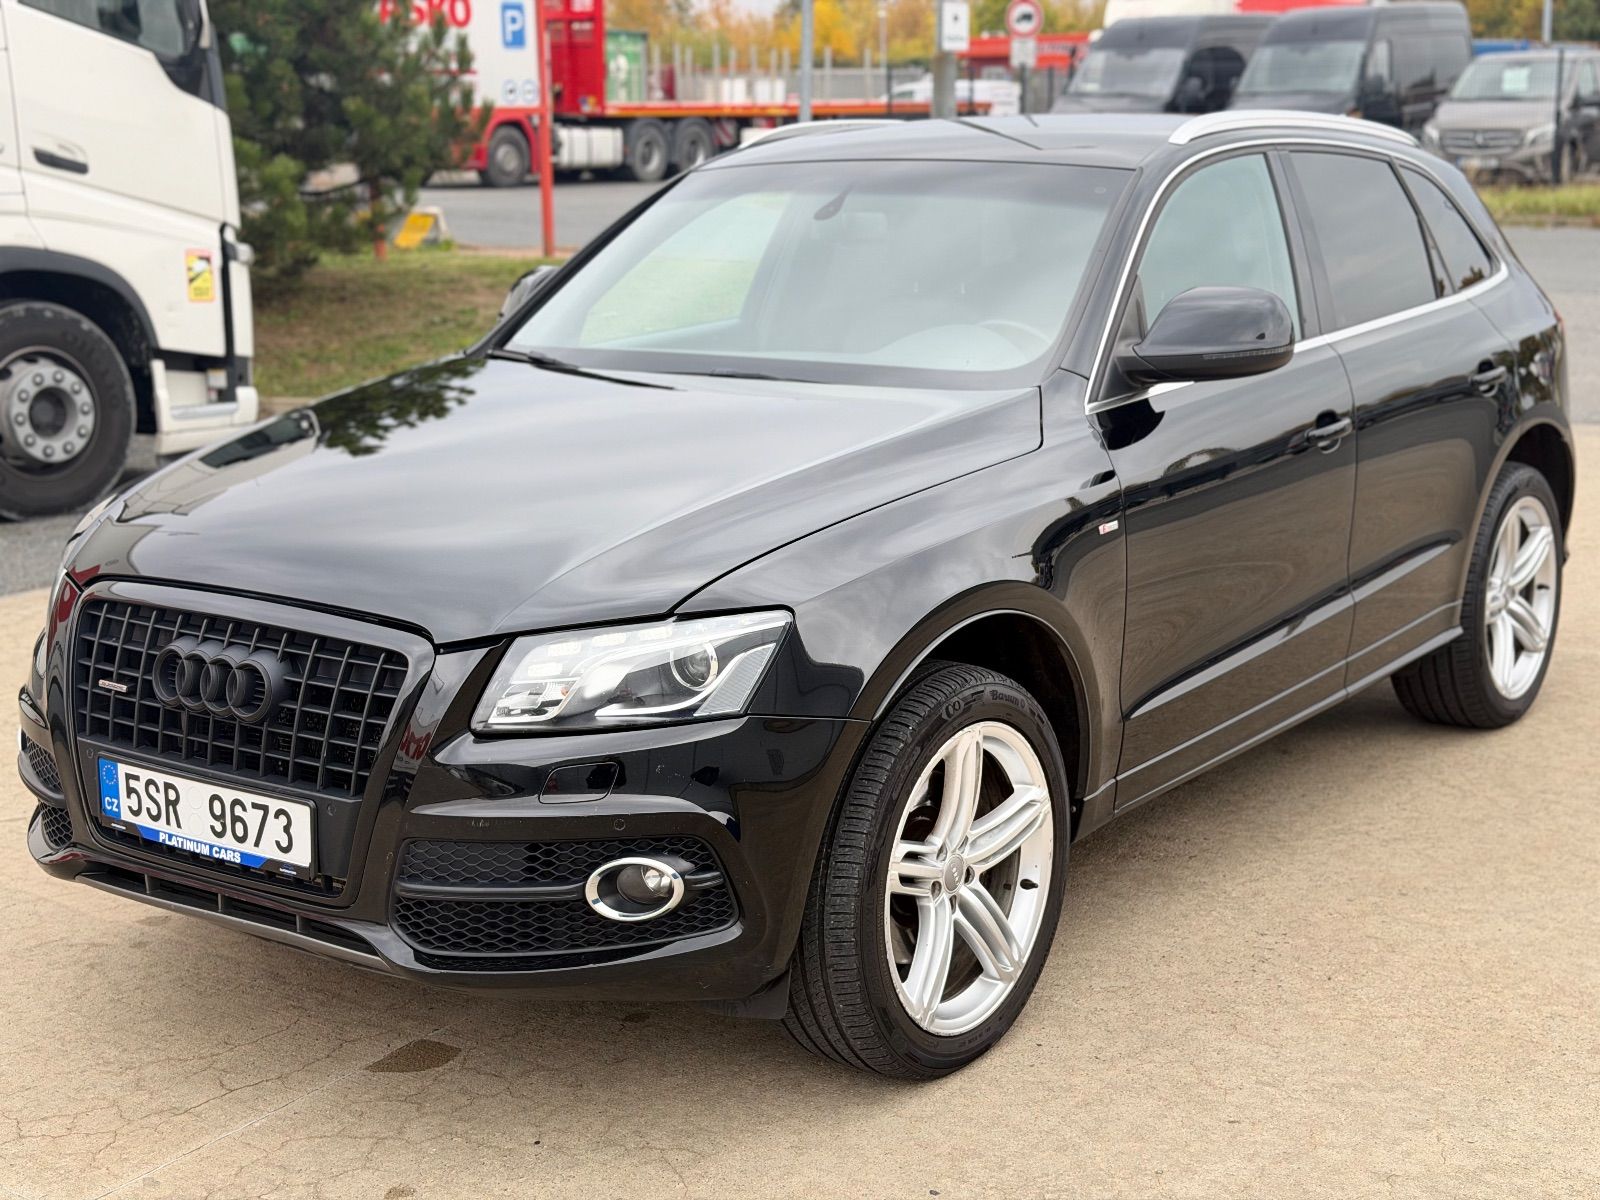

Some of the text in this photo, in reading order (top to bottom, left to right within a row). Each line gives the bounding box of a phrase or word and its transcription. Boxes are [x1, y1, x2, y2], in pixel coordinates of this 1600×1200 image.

[503, 9, 524, 43] P
[104, 796, 119, 813] CZ
[124, 772, 294, 854] 5SR 9673
[159, 831, 242, 864] PLATINUM CARS
